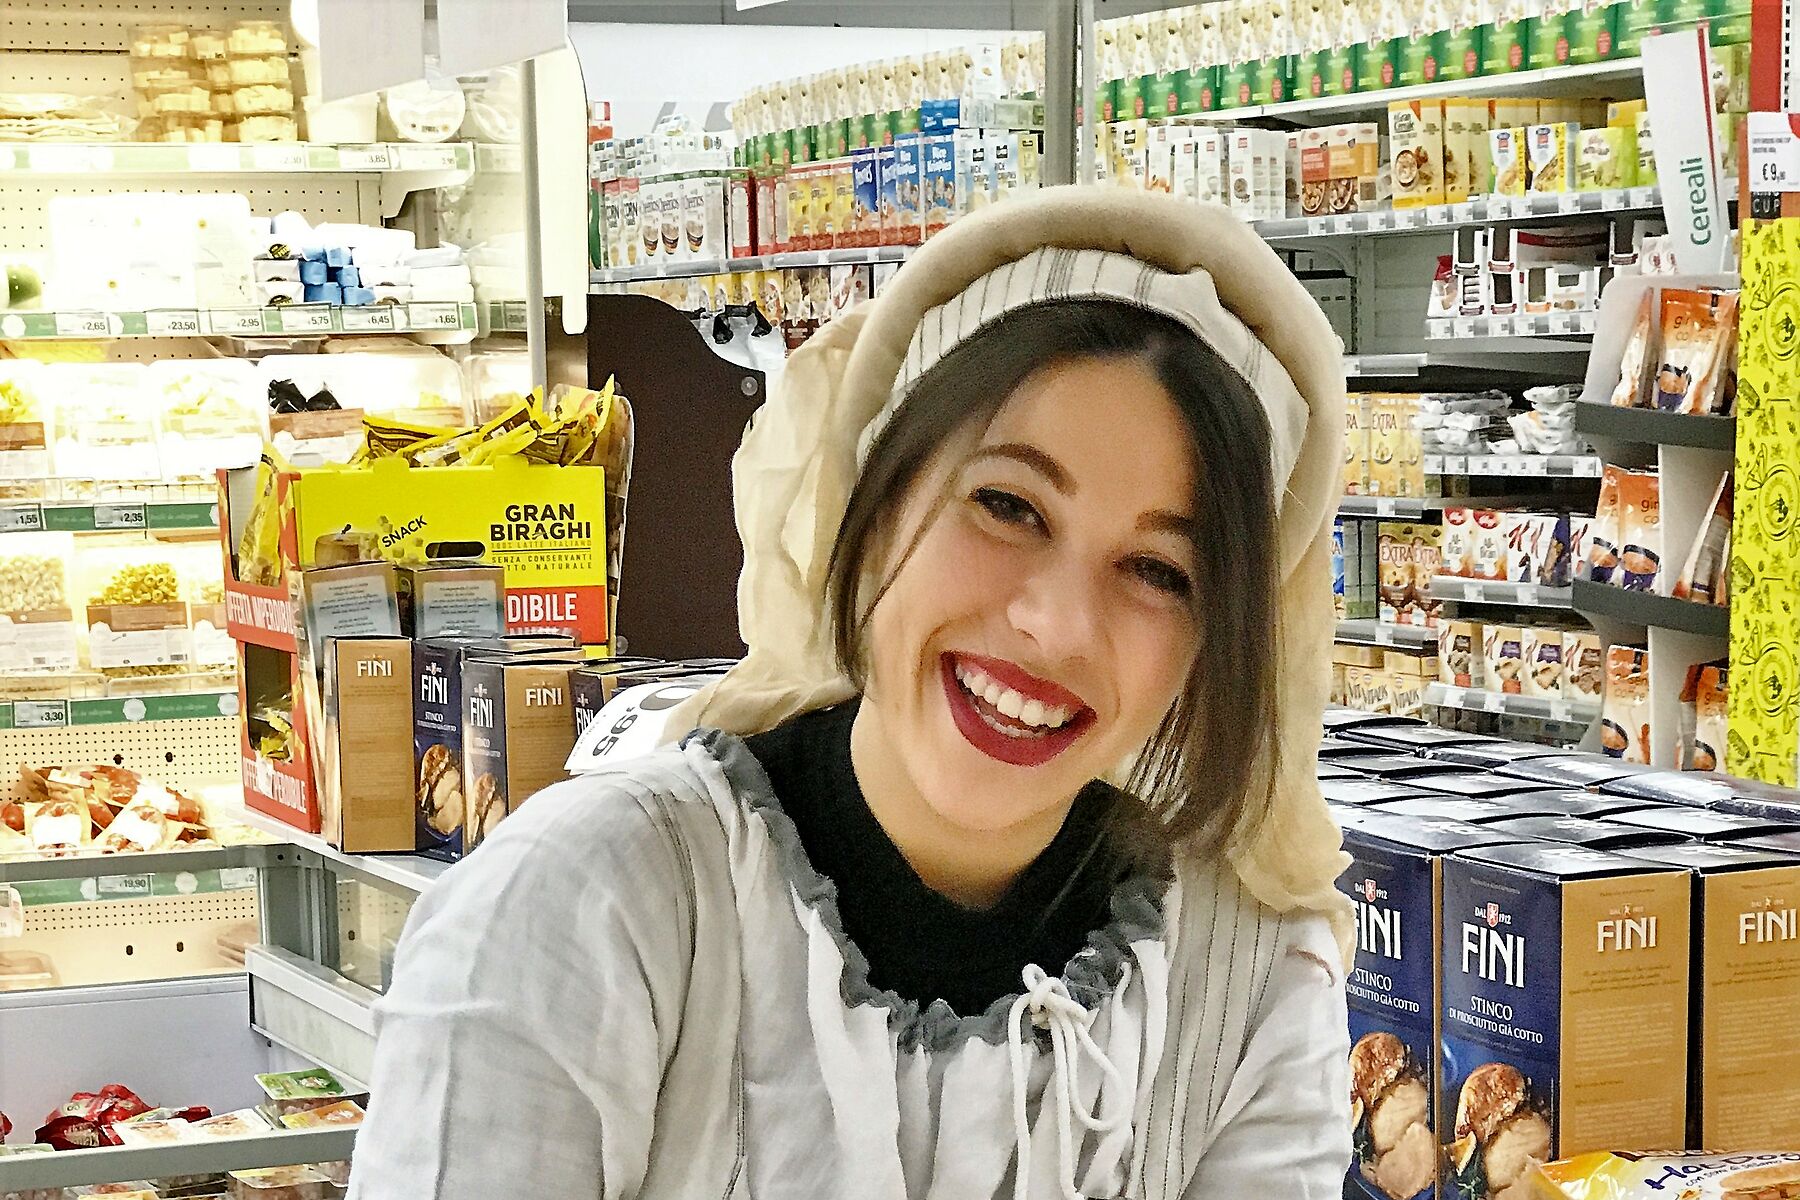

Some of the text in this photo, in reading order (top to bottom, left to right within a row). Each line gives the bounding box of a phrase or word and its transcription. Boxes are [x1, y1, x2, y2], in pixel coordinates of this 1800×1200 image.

[1680, 156, 1712, 246] Cereali
[505, 503, 575, 522] GRAN
[381, 514, 428, 548] SNACK
[490, 522, 591, 542] BIRAGHI
[492, 554, 592, 564] SENZA CONSERVANTI
[536, 562, 592, 571] NATURALE
[357, 660, 392, 677] FINI
[421, 674, 448, 705] FINI
[525, 687, 562, 707] FINI
[469, 697, 494, 728] FINI
[1354, 882, 1388, 900] DAL 1912
[1474, 906, 1512, 925] DAL 1912
[1739, 908, 1797, 945] FINI
[1597, 916, 1657, 953] FINI
[1461, 921, 1525, 989] FINI
[1355, 967, 1393, 992] STINCO
[1380, 992, 1394, 1007] GIÀ
[1393, 997, 1420, 1013] COTTO
[1470, 994, 1513, 1021] STINCO
[1456, 1009, 1498, 1033] PROSCIUTTO
[1498, 1018, 1514, 1037] GIÀ
[1513, 1026, 1544, 1044] COTTO
[1644, 1162, 1726, 1190] Hot
